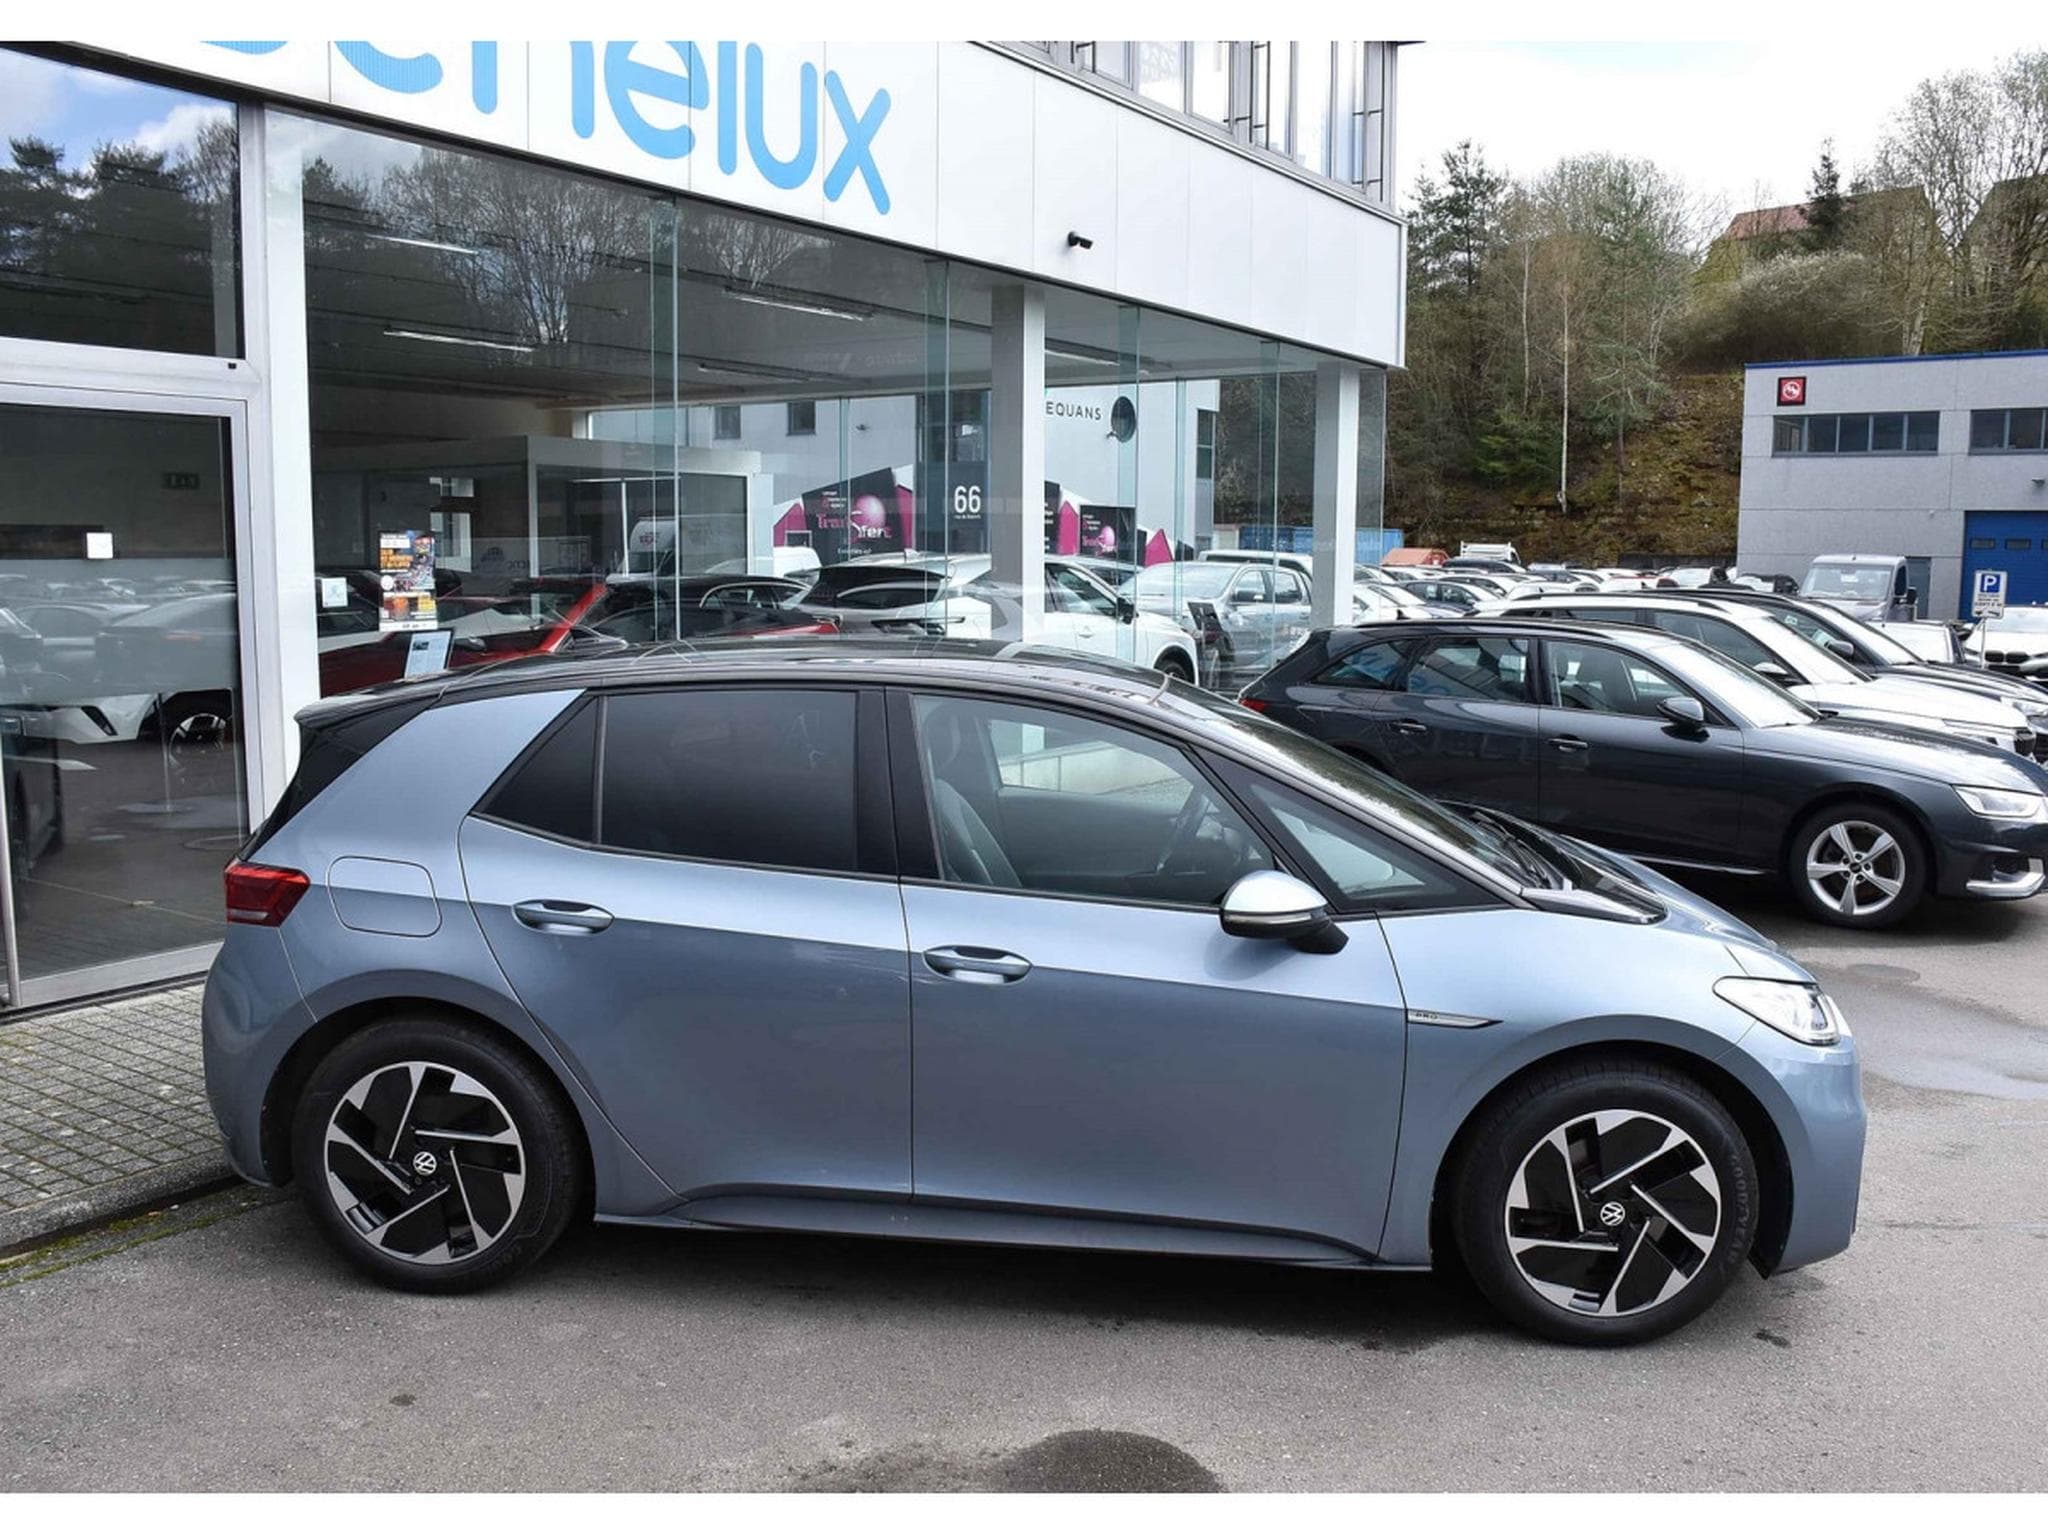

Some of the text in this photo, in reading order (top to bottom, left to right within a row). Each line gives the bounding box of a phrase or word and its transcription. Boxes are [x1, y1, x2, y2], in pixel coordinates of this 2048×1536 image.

[1045, 401, 1102, 421] EQUANS
[954, 485, 981, 513] 66
[1983, 575, 1998, 592] P
